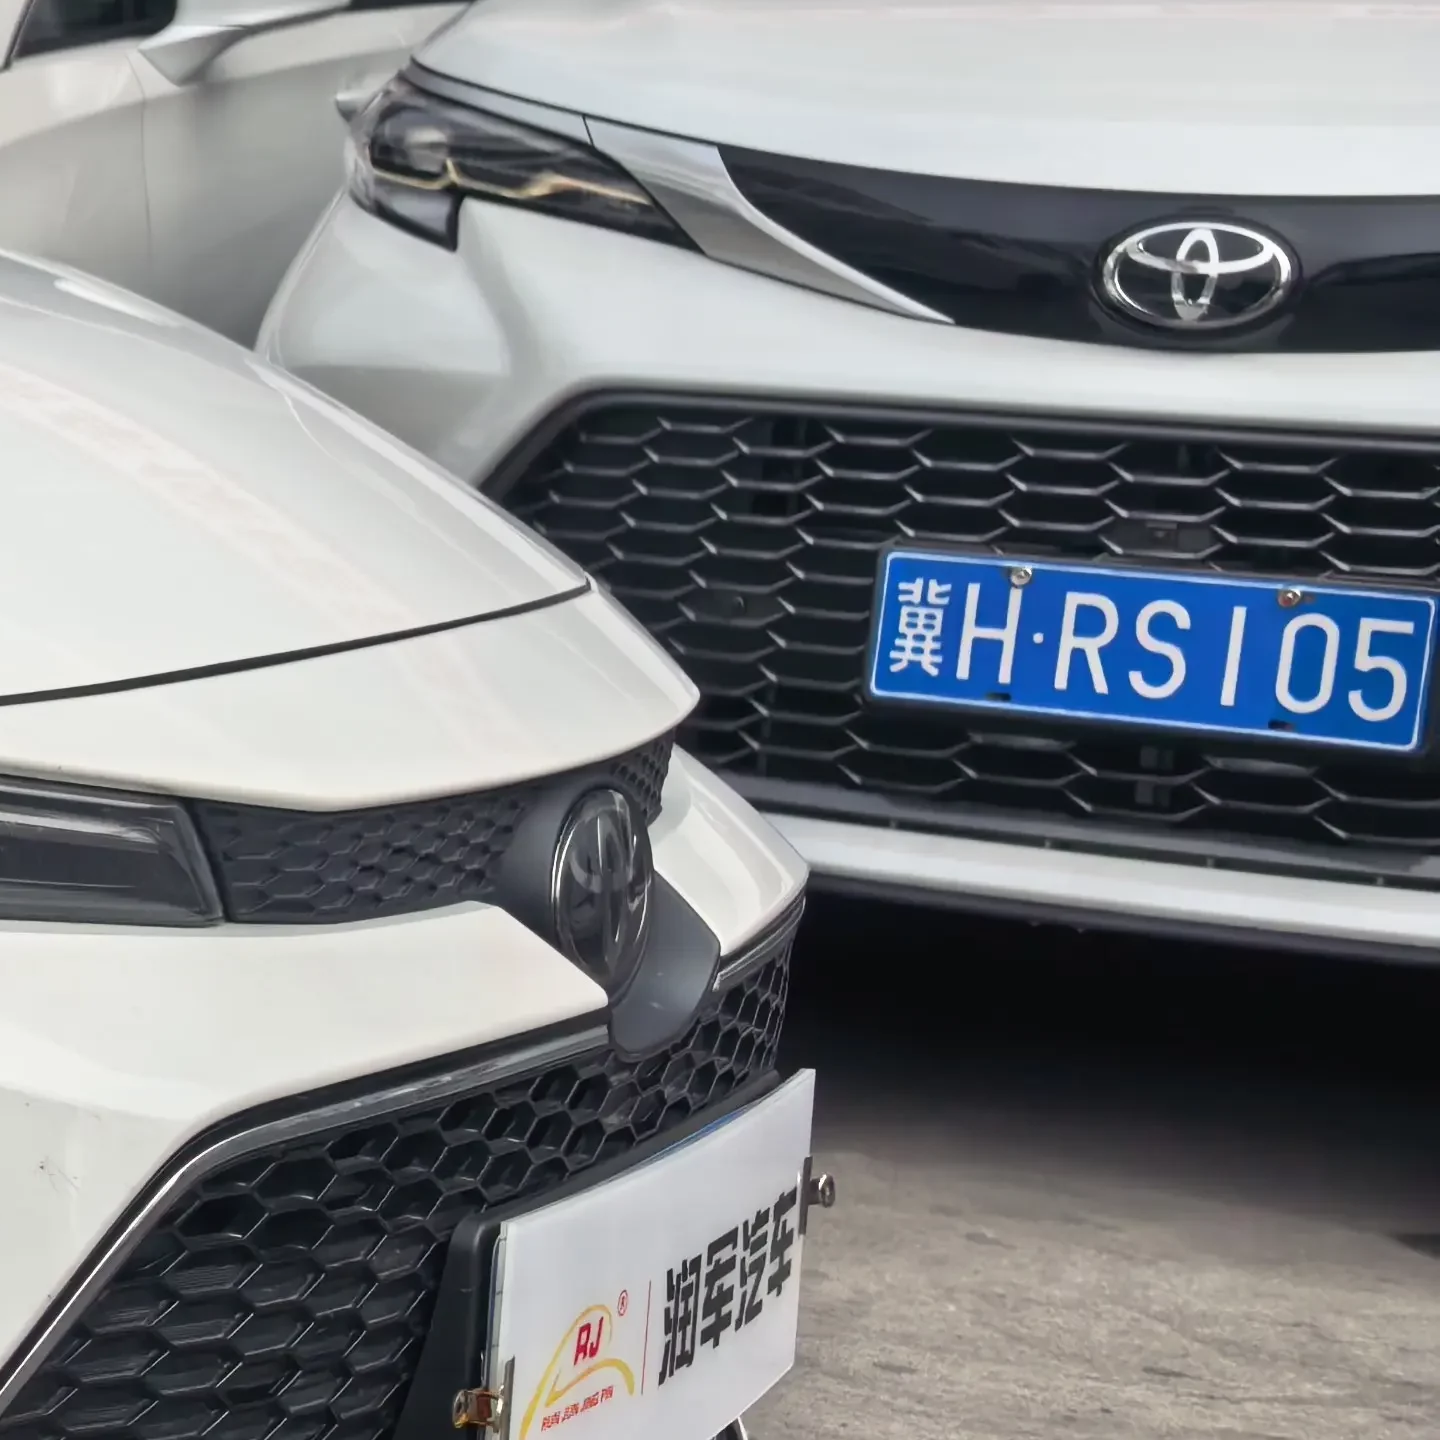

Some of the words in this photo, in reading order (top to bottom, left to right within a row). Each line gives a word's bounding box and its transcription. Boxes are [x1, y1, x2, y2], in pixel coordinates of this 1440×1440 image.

[573, 1316, 604, 1366] RJ
[657, 1185, 797, 1387] 润军汽车
